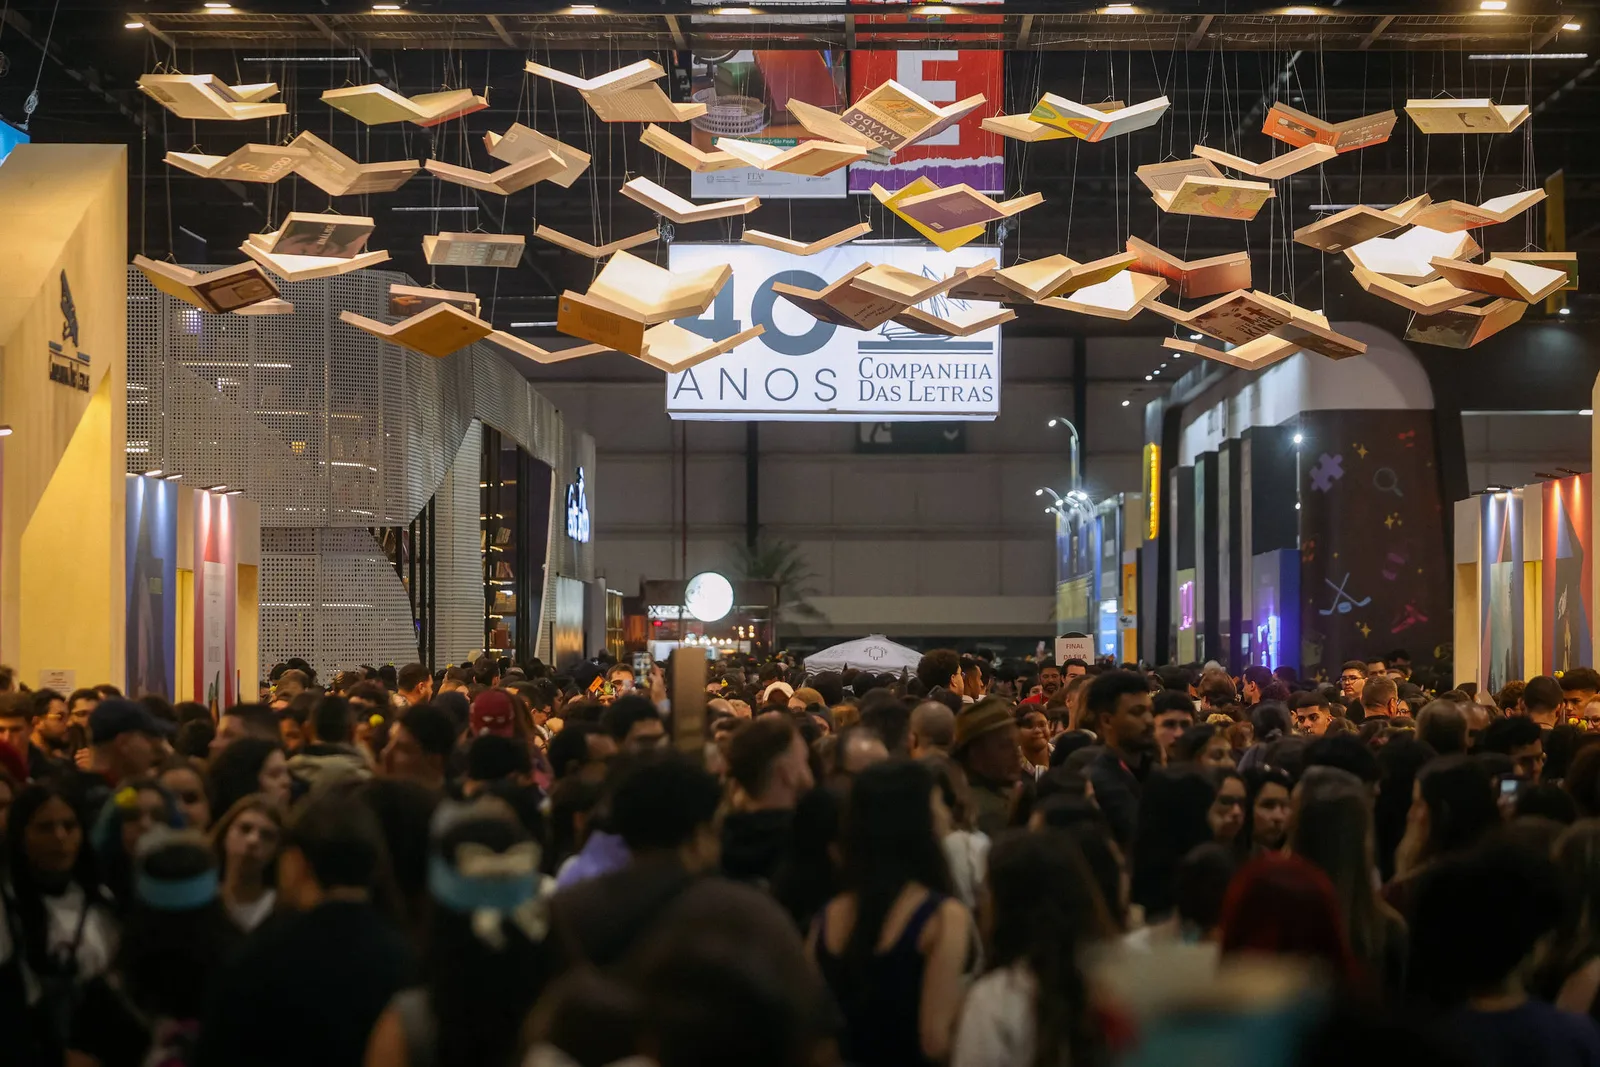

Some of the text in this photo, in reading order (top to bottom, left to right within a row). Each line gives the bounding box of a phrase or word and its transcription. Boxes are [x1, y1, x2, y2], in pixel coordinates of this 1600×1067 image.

[846, 118, 891, 146] JORGE
[854, 112, 901, 141] AMADO
[673, 269, 838, 356] 40
[1239, 315, 1270, 331] STEPHEN
[1242, 317, 1284, 338] KING
[858, 356, 993, 381] COMPANHIA
[673, 367, 838, 402] ANOS
[858, 380, 994, 403] DAS LETRAS
